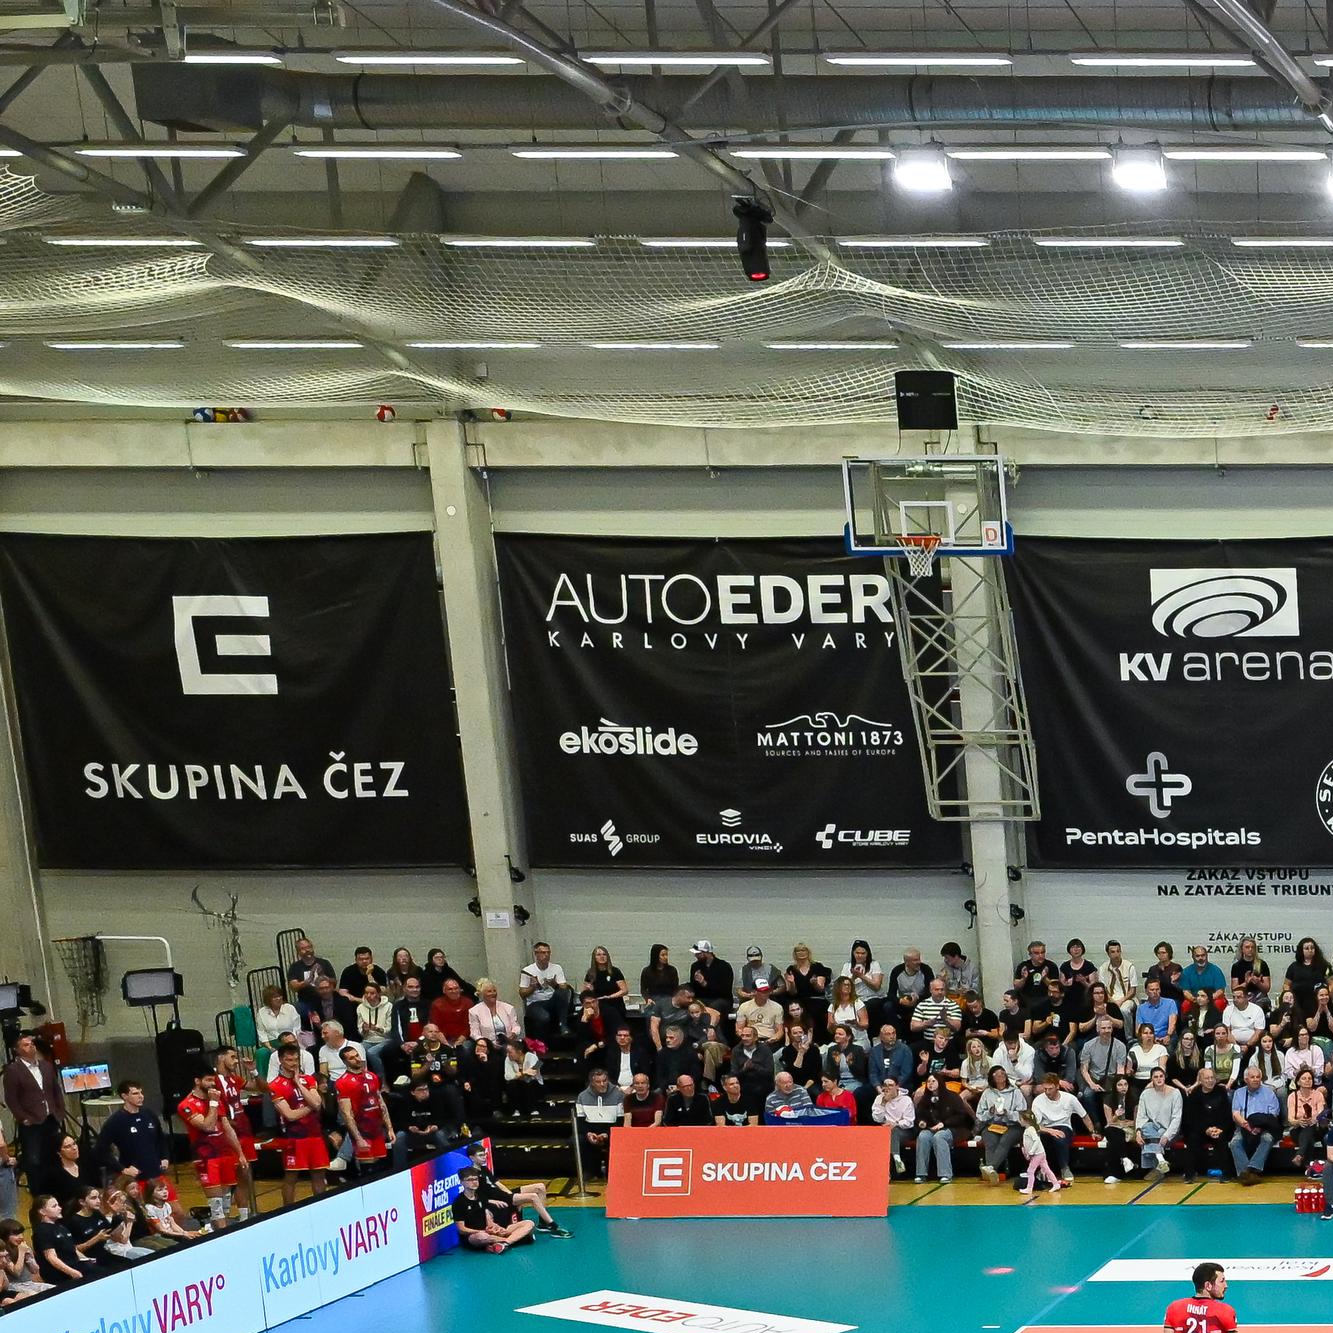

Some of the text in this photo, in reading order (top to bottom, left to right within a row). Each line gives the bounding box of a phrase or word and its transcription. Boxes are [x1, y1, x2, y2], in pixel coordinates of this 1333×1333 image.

[545, 573, 895, 625] AUTOEDER
[547, 631, 896, 650] KARLOVY VARY
[1118, 653, 1172, 682] KV
[559, 722, 699, 757] ekoslide
[757, 730, 904, 747] MATTONI 1873
[83, 751, 410, 801] SKUPINA ČEZ
[569, 833, 598, 843] SUAS
[625, 833, 661, 844] GROUP
[696, 833, 773, 845] EUROVIA
[837, 830, 911, 842] CUBE
[1065, 827, 1262, 849] PentaHospitals
[1245, 867, 1310, 881] VSTUPU
[1157, 884, 1180, 897] NA
[1183, 880, 1267, 897] ZATAŽENÉ
[1249, 932, 1292, 941] VSTUPU
[701, 1157, 858, 1182] SKUPINA ČEZ
[433, 1180, 445, 1195] ČEZ
